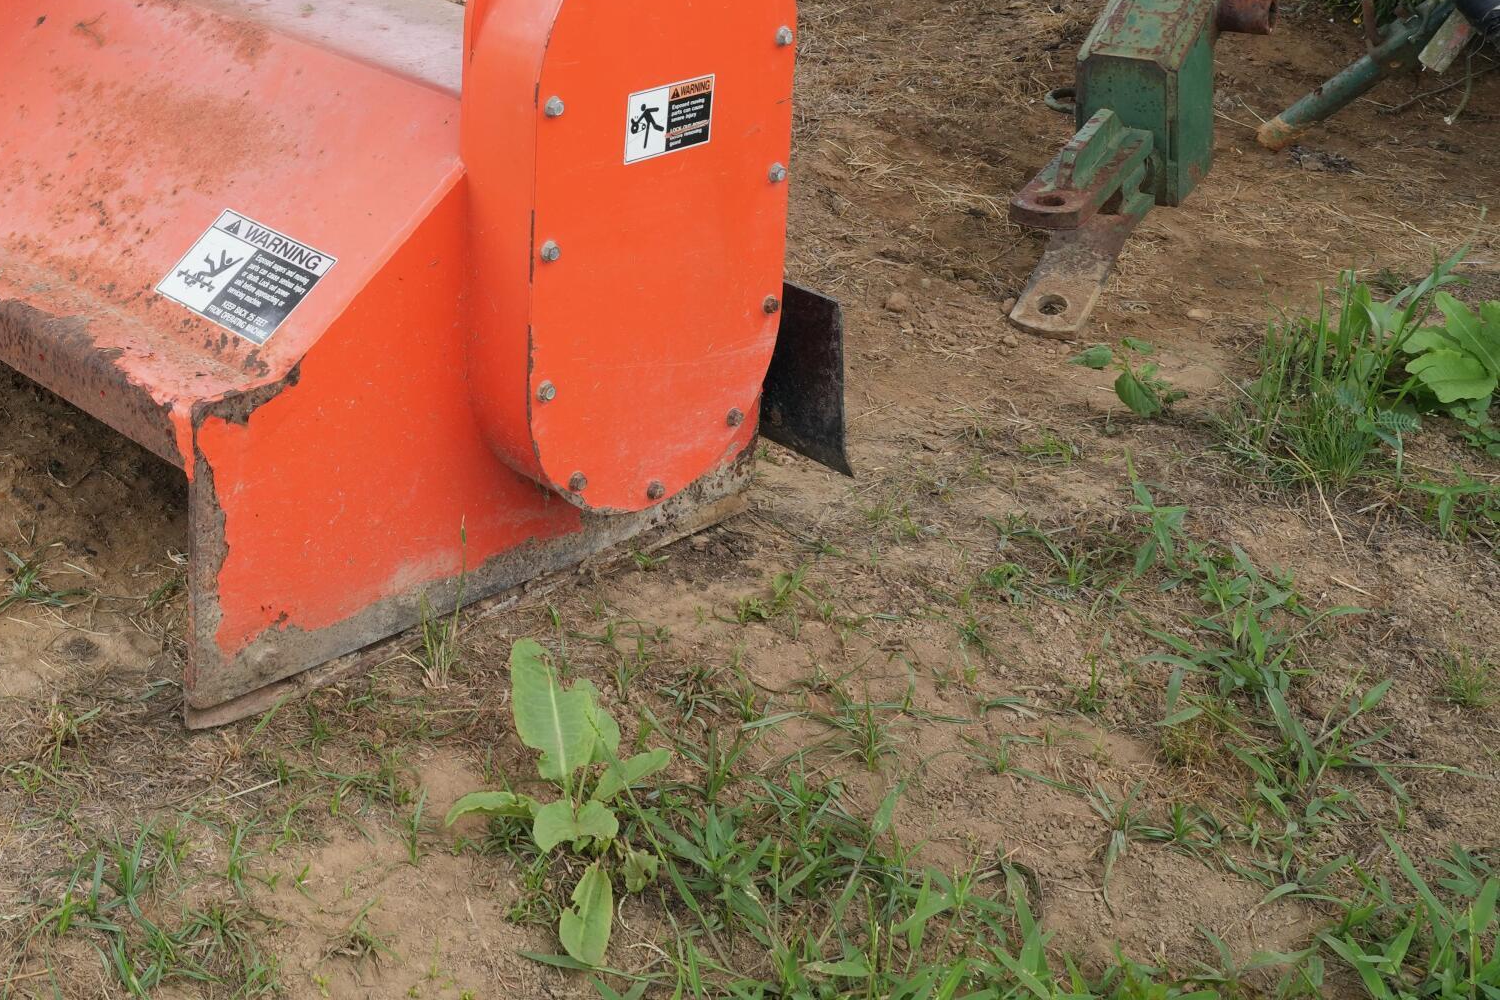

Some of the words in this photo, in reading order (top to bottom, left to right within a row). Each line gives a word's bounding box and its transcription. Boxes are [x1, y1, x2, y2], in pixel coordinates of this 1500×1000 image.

[681, 80, 710, 96] WARNING
[244, 225, 322, 271] WARNING
[255, 254, 275, 267] Exposed
[285, 269, 297, 277] and
[259, 279, 271, 288] Lock
[208, 305, 223, 316] FROM
[221, 311, 248, 329] OPERATING
[222, 301, 237, 311] KEEP
[234, 307, 249, 318] BACK
[247, 313, 256, 321] 25
[253, 317, 268, 327] FEET
